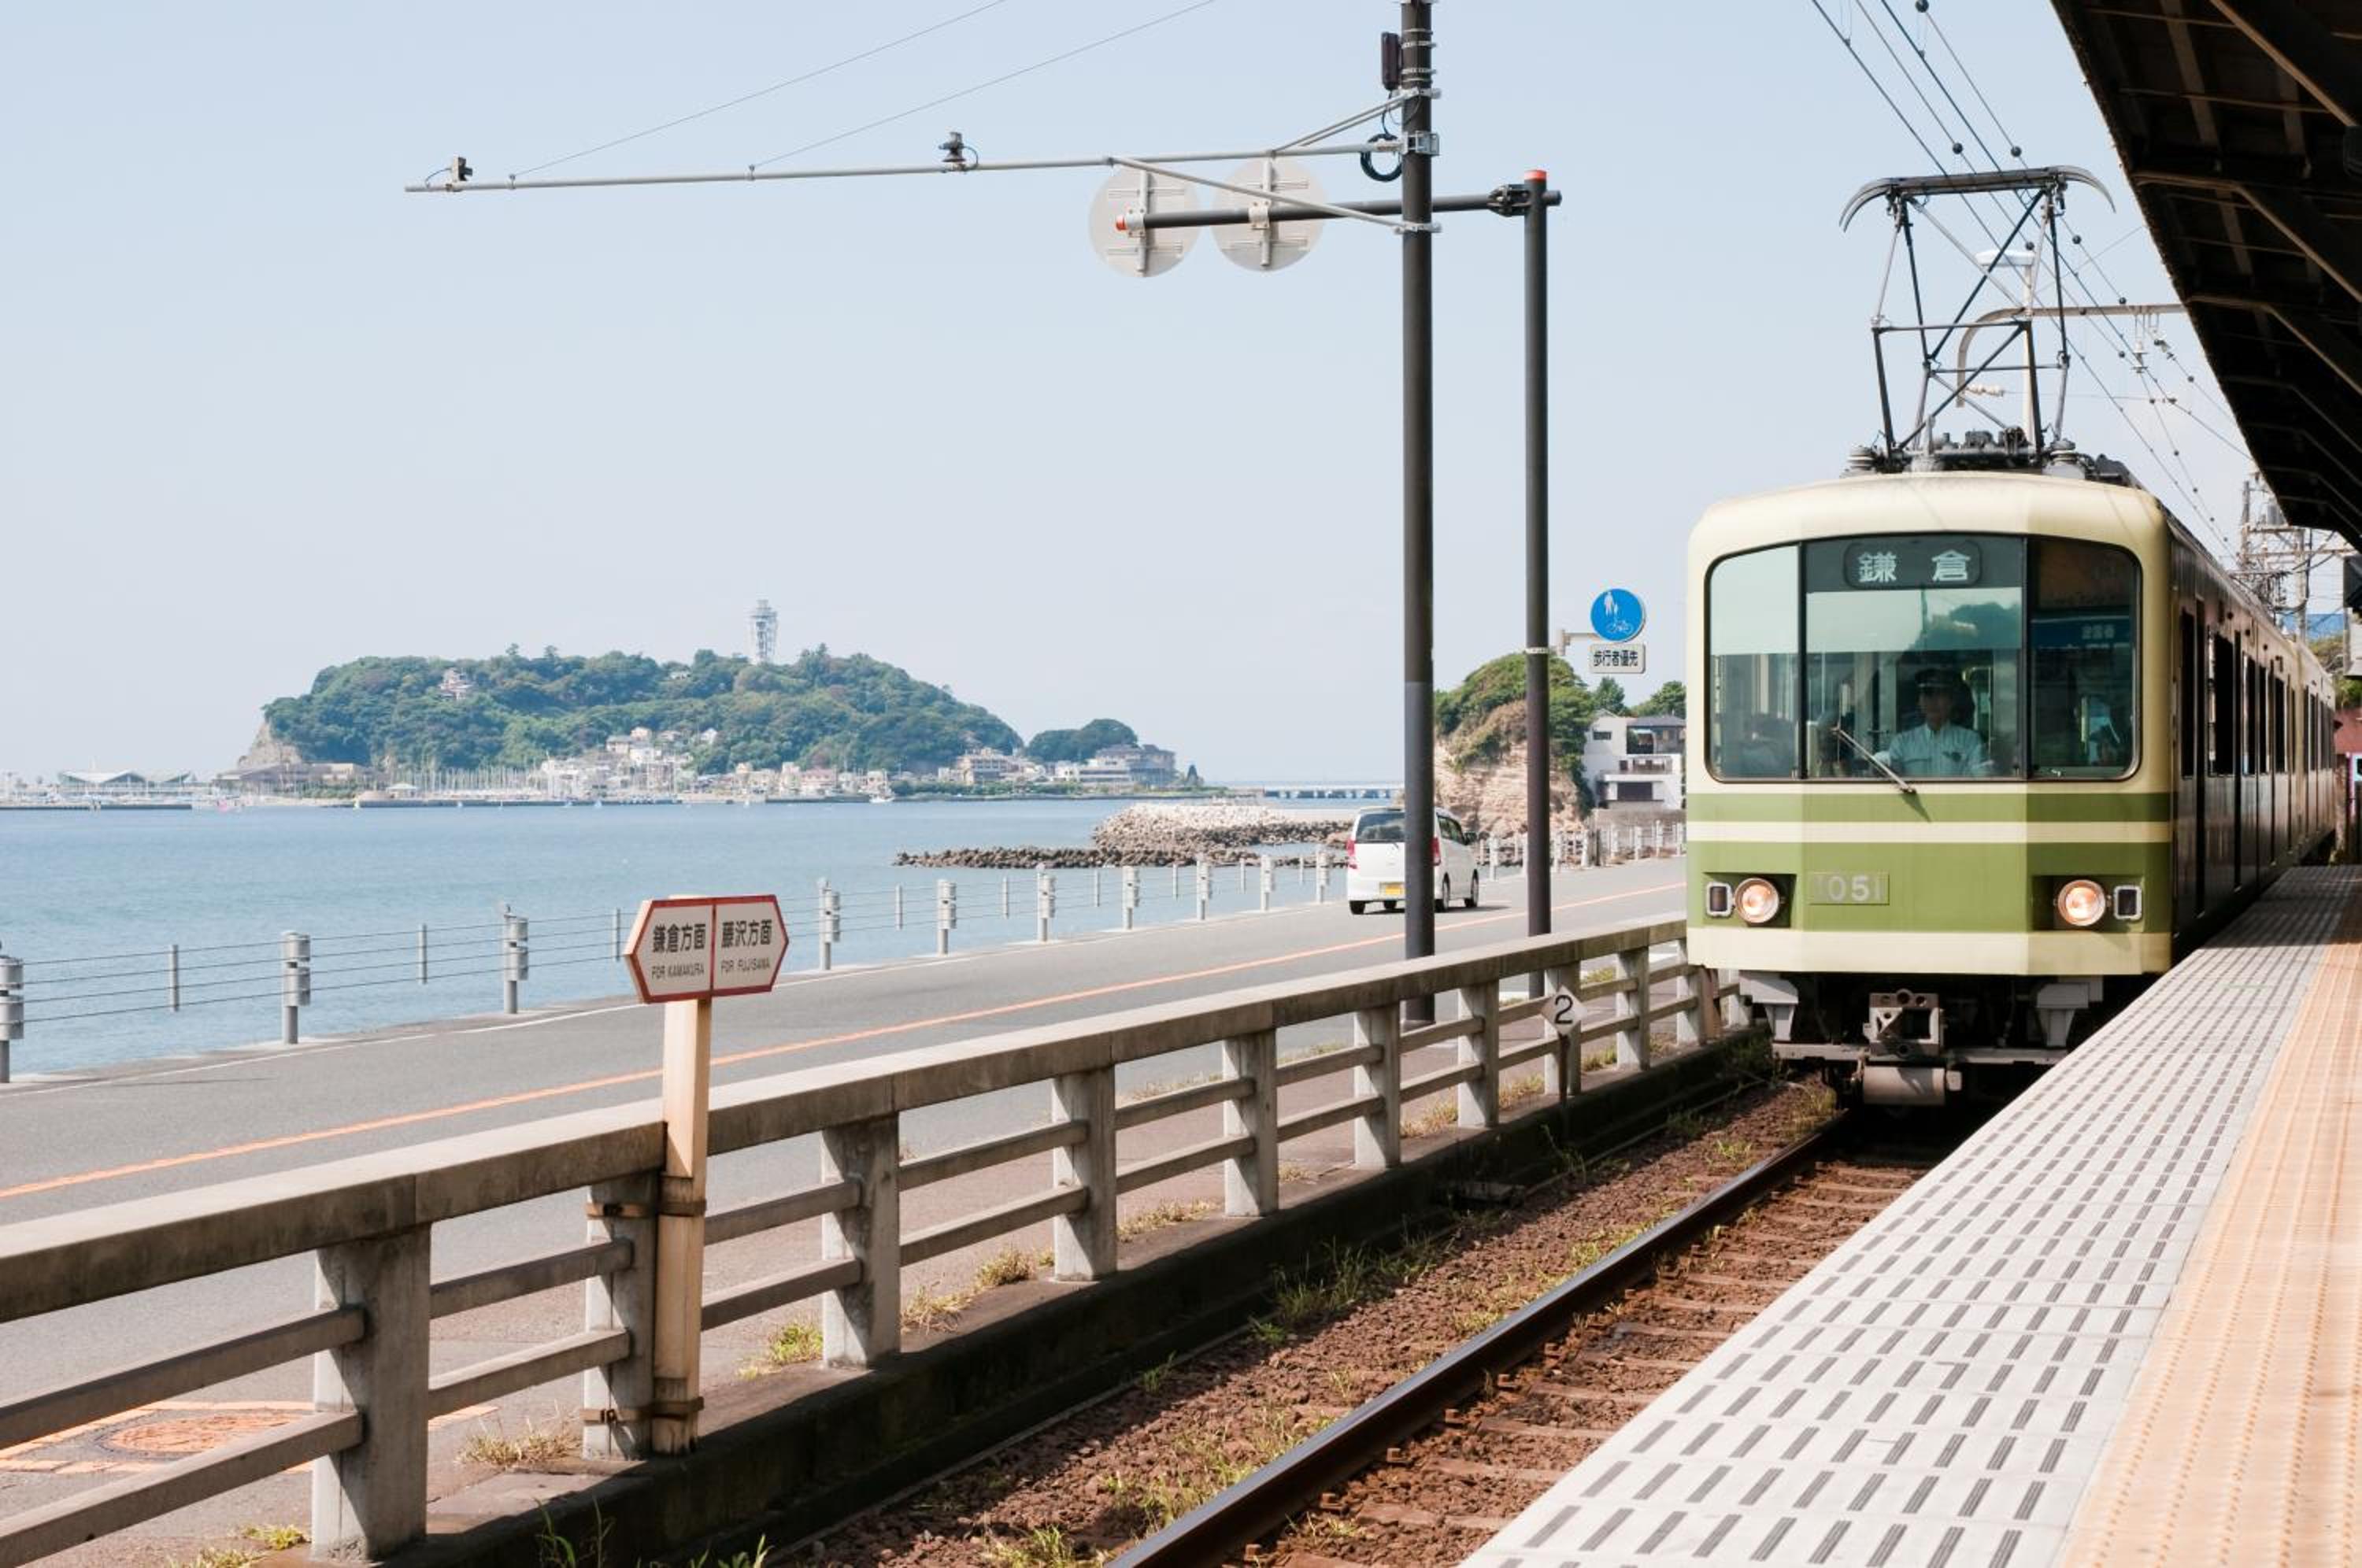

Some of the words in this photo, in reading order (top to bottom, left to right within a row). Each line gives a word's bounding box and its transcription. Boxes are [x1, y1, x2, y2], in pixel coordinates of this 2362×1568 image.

[1857, 549, 1971, 583] 鎌倉
[1593, 649, 1638, 667] 歩行者優先
[652, 923, 706, 953] 鎌倉方面
[720, 919, 773, 949] 藤沢方面
[651, 964, 666, 980] FOR
[668, 962, 705, 978] KAMAKURA
[720, 959, 734, 974] FOR
[737, 956, 771, 973] FUJISAWA
[1554, 994, 1573, 1024] 2
